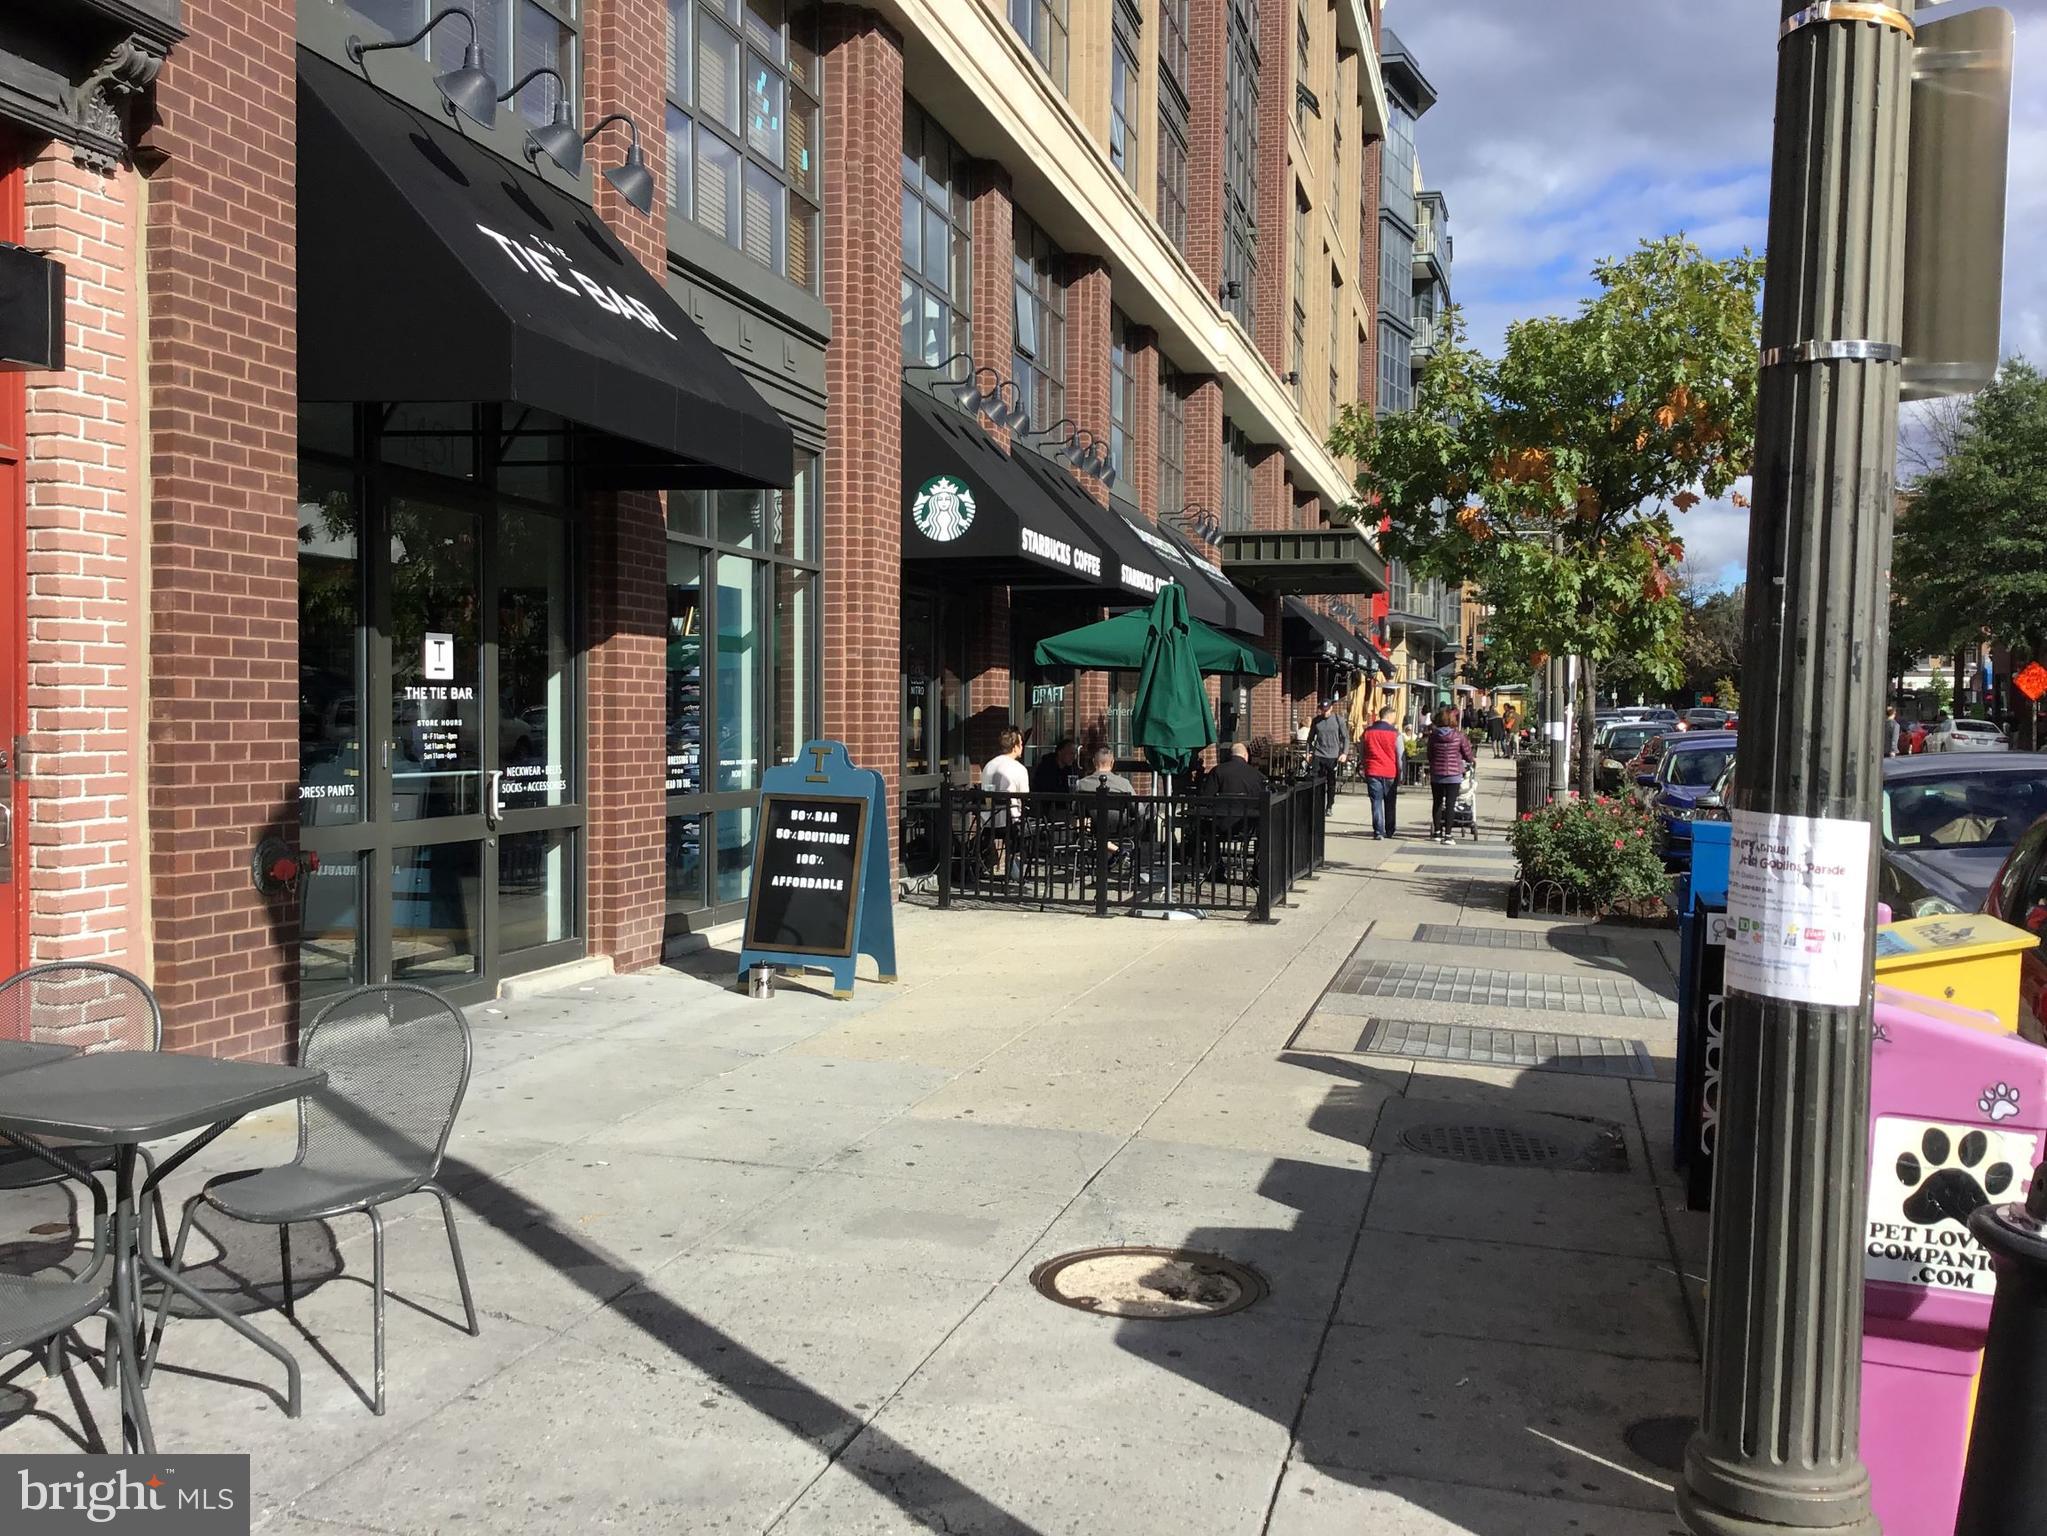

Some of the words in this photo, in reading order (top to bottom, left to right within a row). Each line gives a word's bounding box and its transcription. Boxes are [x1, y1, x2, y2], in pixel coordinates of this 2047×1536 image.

[529, 233, 573, 262] THE
[476, 223, 581, 297] TIE
[568, 268, 678, 341] BAR
[1021, 527, 1071, 567] STARBUCKS
[1073, 547, 1101, 577] COFFEE
[1121, 563, 1154, 593] STARBUCKS
[405, 686, 428, 700] THE
[429, 686, 448, 700] TIE
[450, 686, 474, 700] BAR
[1032, 685, 1065, 705] DRAFT
[417, 719, 439, 727] STORE
[506, 765, 541, 777] NECKWEAR
[327, 784, 355, 797] PANTS
[501, 782, 523, 794] SOCKS
[796, 853, 824, 865] 100%
[1760, 857, 1801, 873] Goblins
[1806, 861, 1846, 875] Parade
[771, 875, 844, 891] AFFORDABLE
[1870, 1222, 1917, 1242] PET
[1925, 1228, 1986, 1250] LOV
[1911, 1267, 1975, 1289] .COM
